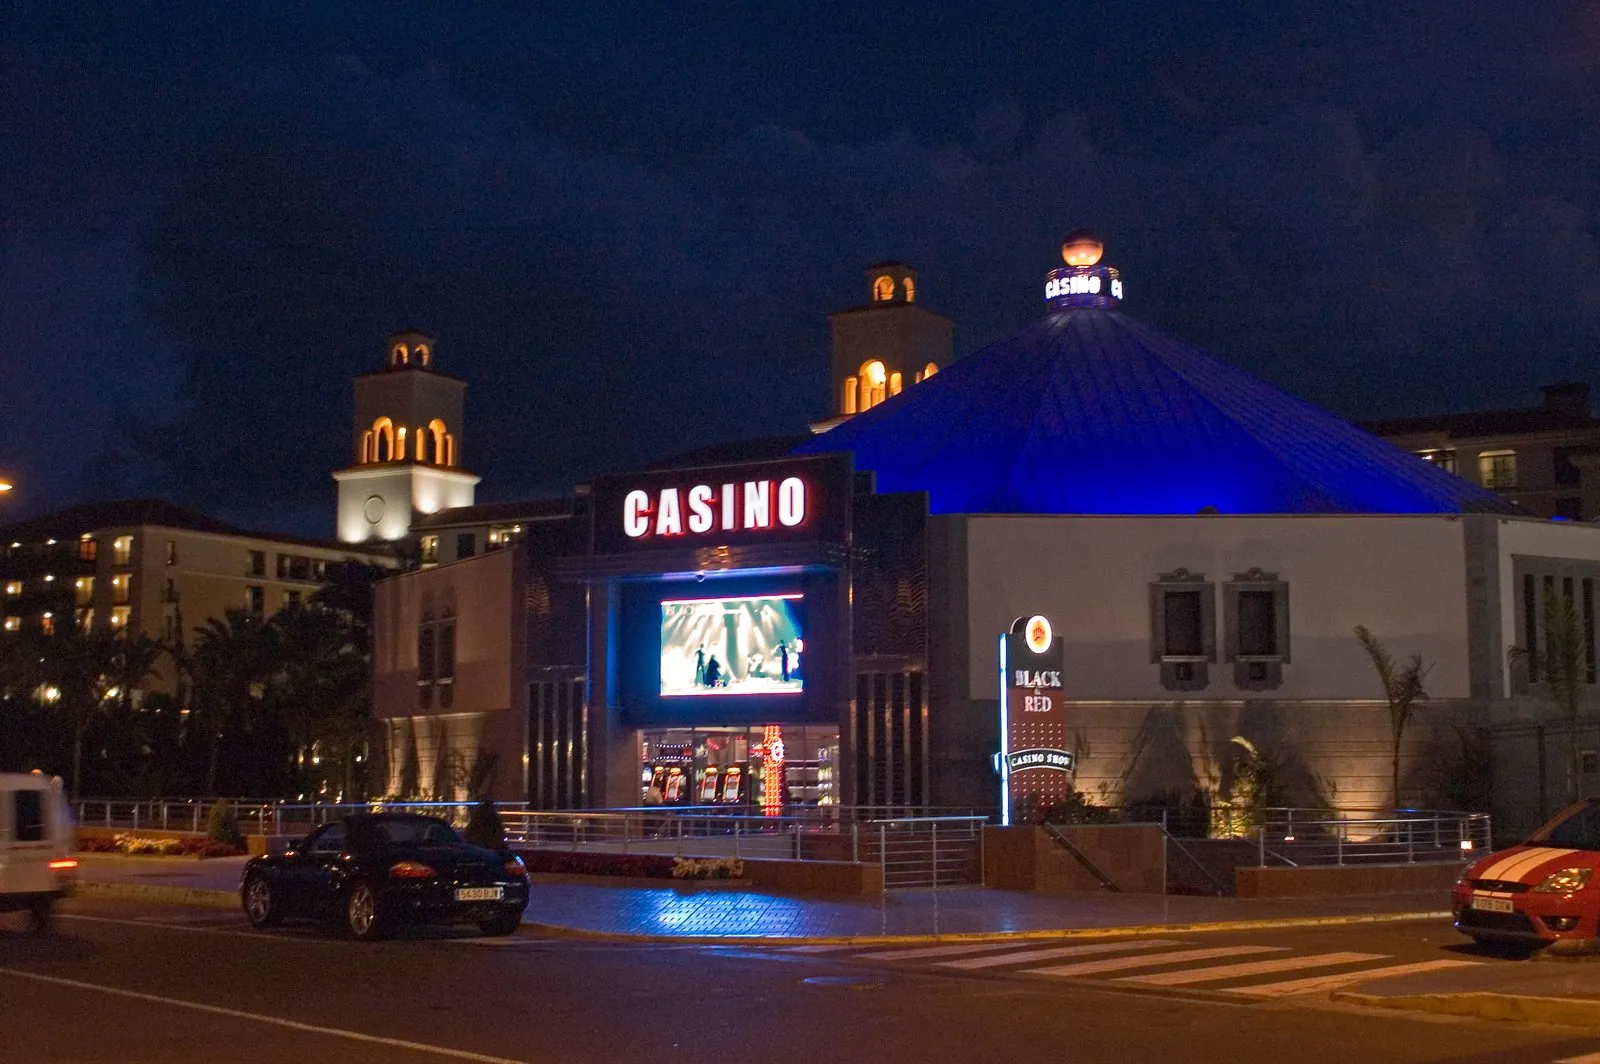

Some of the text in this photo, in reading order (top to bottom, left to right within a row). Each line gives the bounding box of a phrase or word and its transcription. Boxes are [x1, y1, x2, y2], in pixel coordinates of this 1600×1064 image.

[1045, 275, 1100, 299] CASINO
[624, 477, 805, 538] CASINO
[1015, 669, 1061, 687] BLACK
[1024, 696, 1052, 712] RED
[1011, 753, 1071, 767] CASINO SHOW
